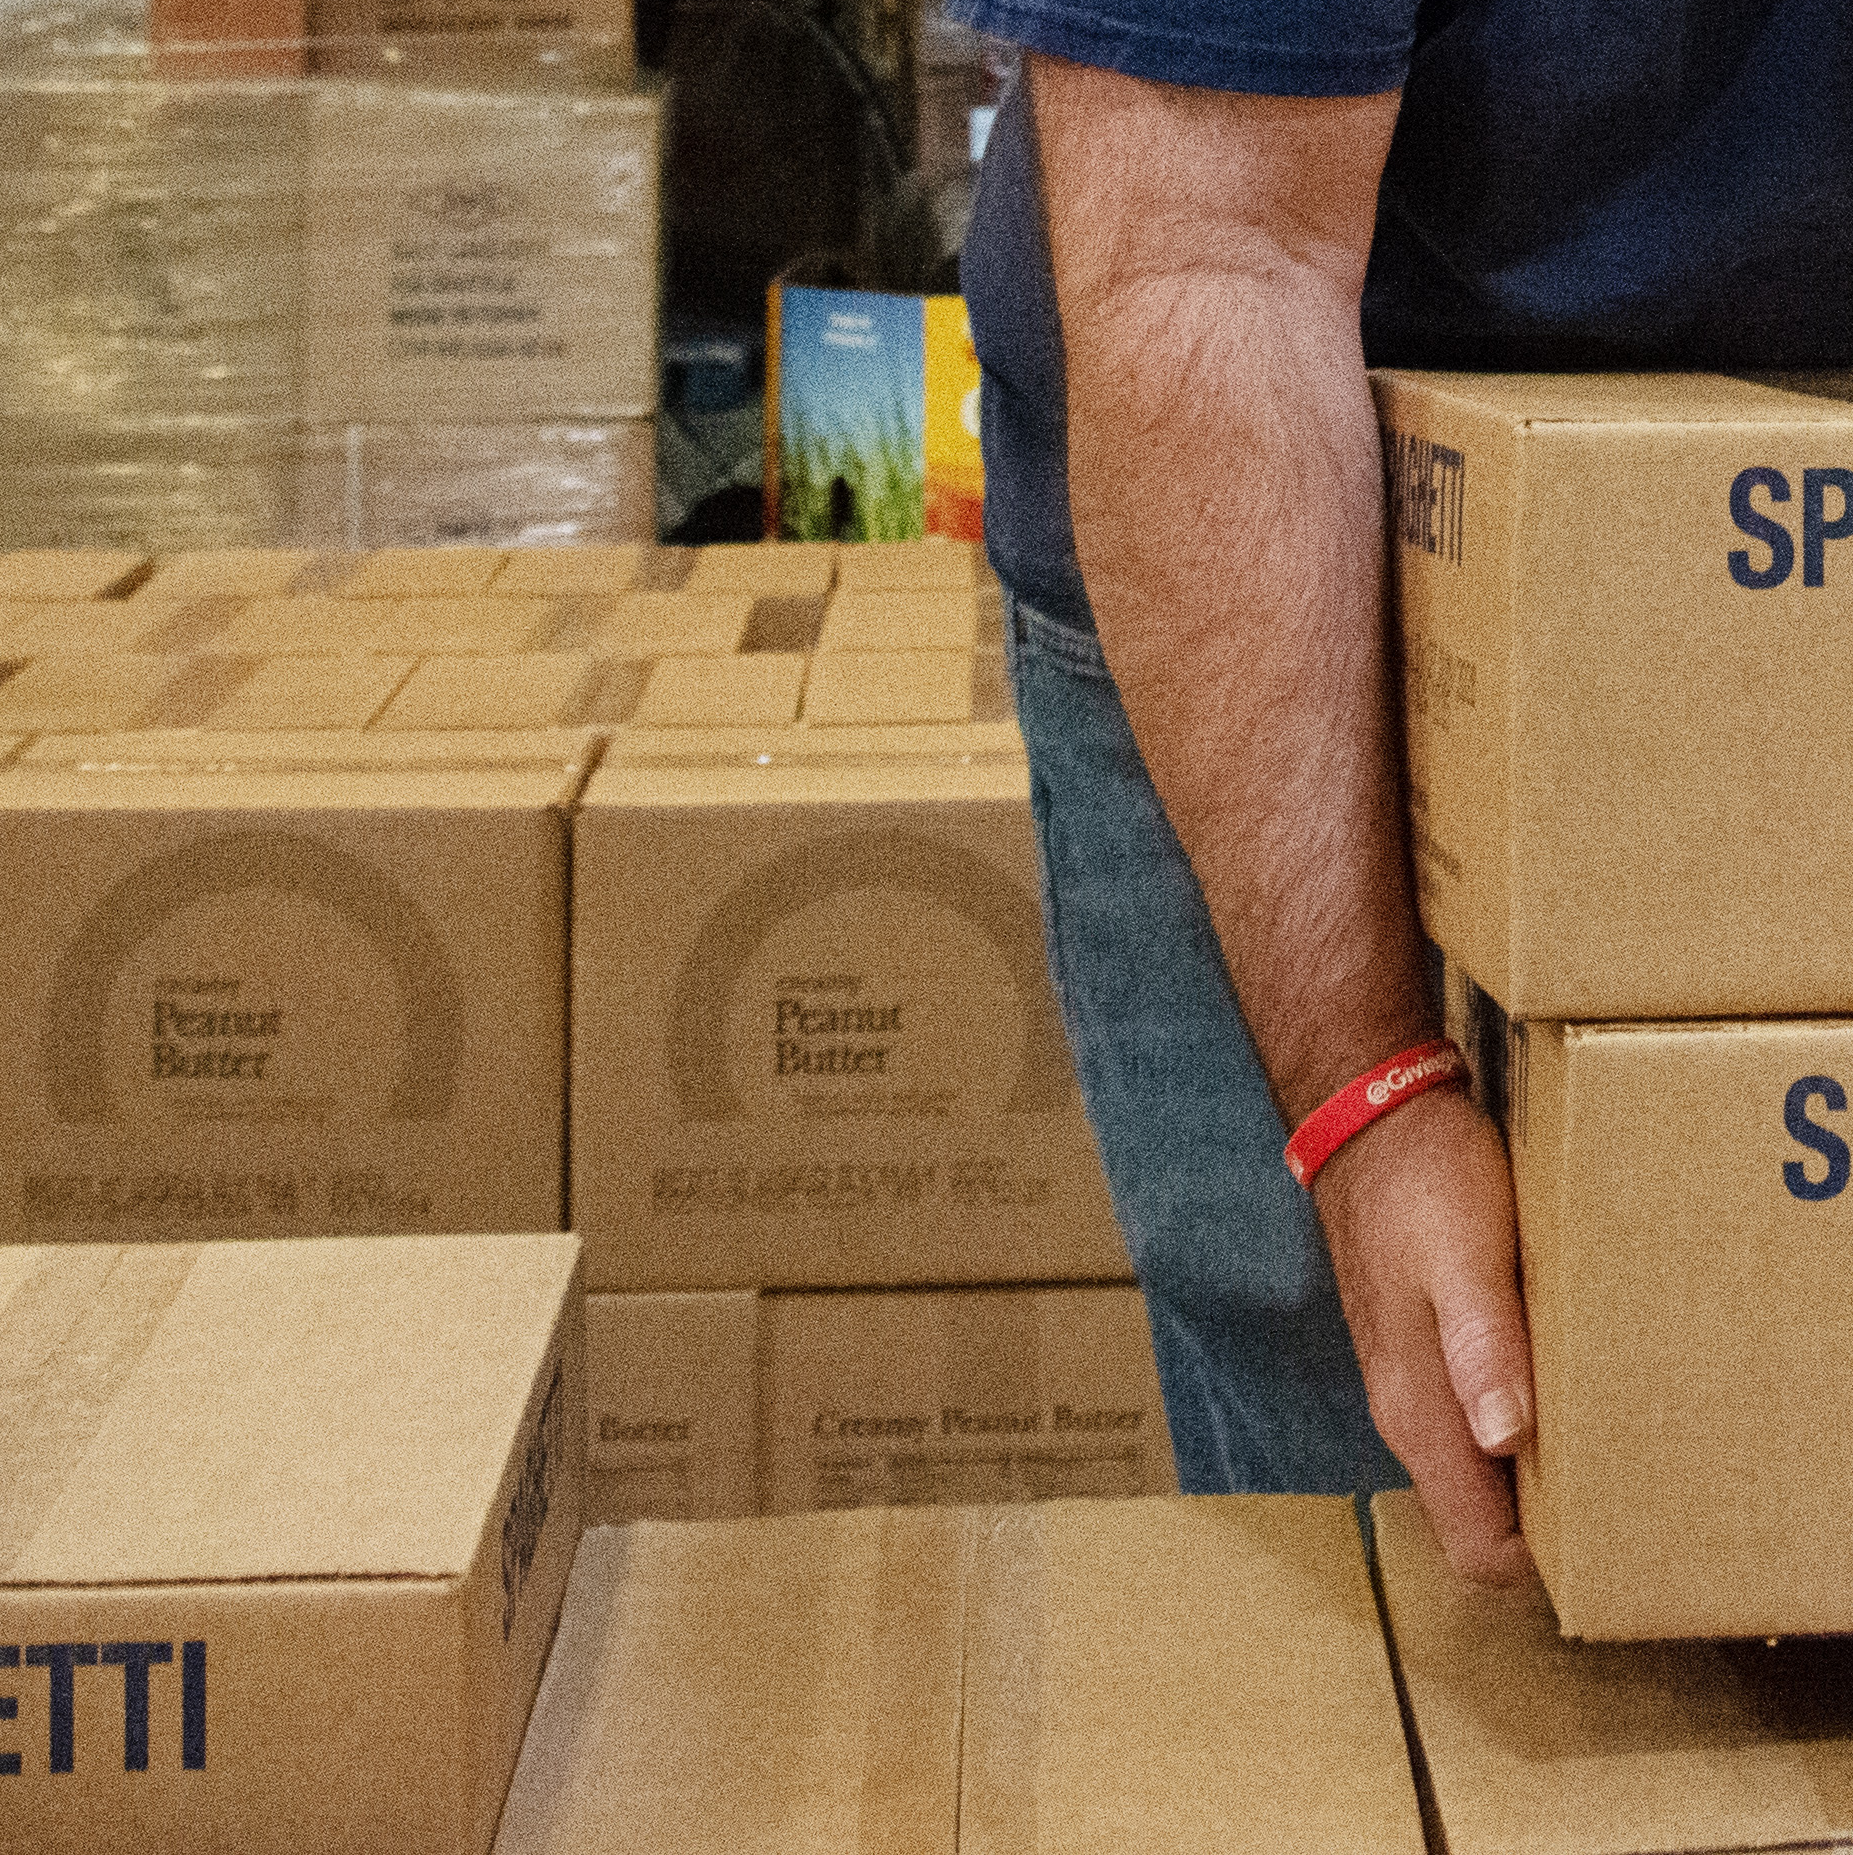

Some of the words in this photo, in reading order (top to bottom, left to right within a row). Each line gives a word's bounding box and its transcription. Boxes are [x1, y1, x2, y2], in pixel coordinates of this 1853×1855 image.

[153, 998, 283, 1038] Peanut
[773, 998, 903, 1036] Peanut
[151, 1039, 272, 1080] Butter
[773, 1038, 889, 1077] Butter
[812, 1409, 932, 1443] Creamy
[941, 1405, 1040, 1436] Peanut
[1051, 1401, 1146, 1433] Butter
